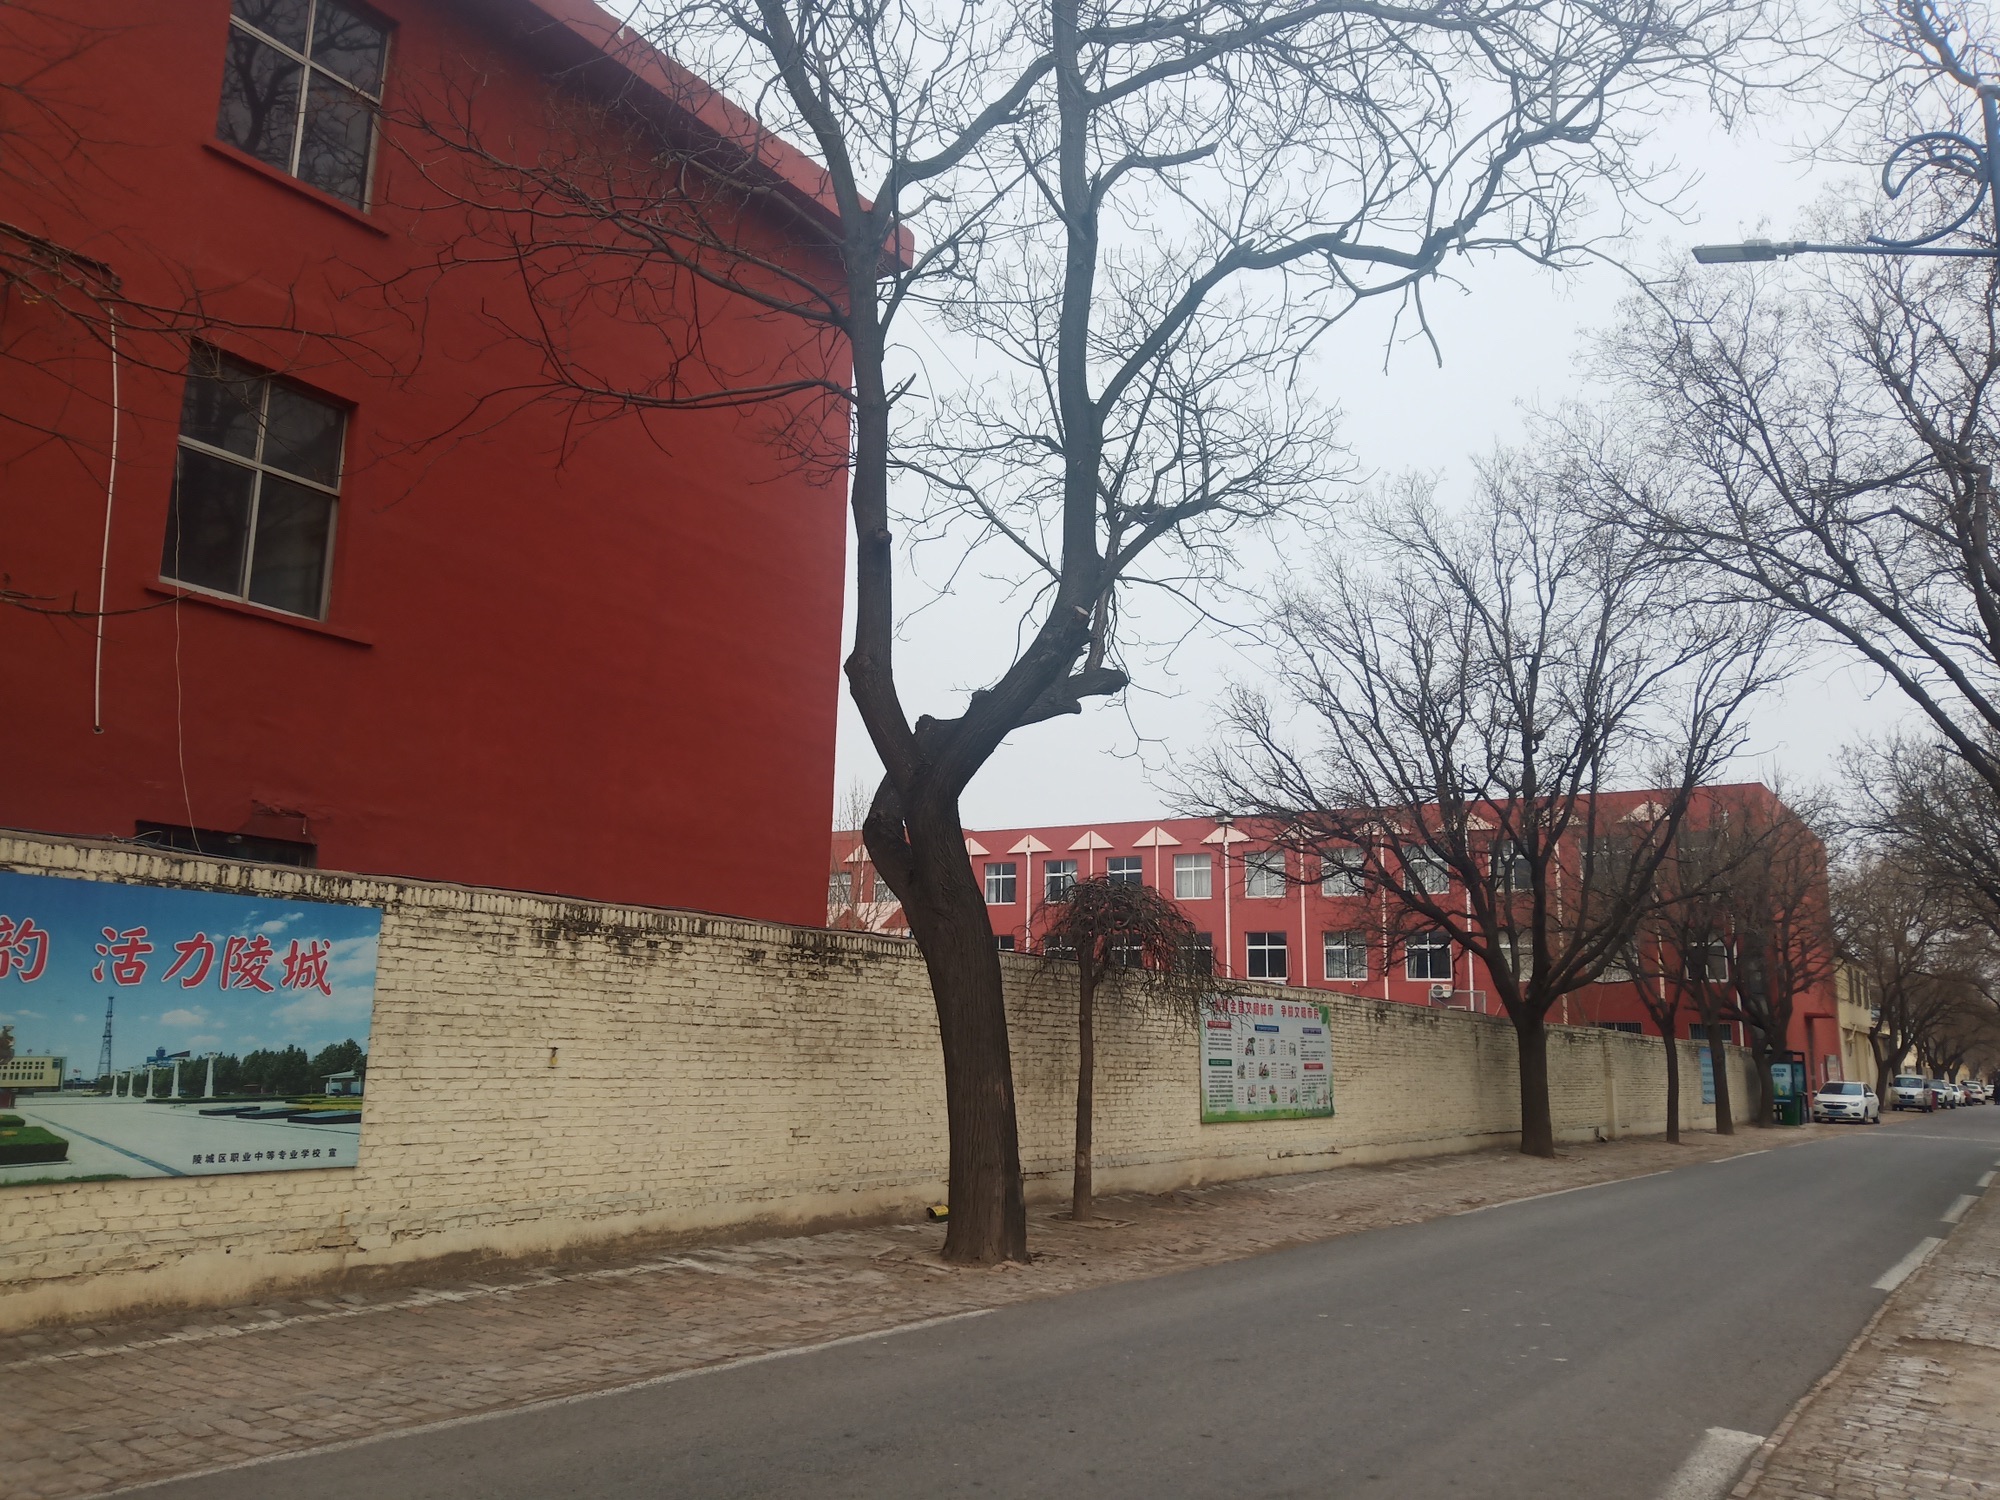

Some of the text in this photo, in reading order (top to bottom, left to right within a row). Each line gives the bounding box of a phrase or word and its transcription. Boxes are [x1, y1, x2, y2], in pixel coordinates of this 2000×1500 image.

[93, 926, 331, 996] 活力陵城
[1281, 1004, 1319, 1020] 争做文明市民
[192, 1147, 338, 1165] 陵城区职业中等专业学校 宣
